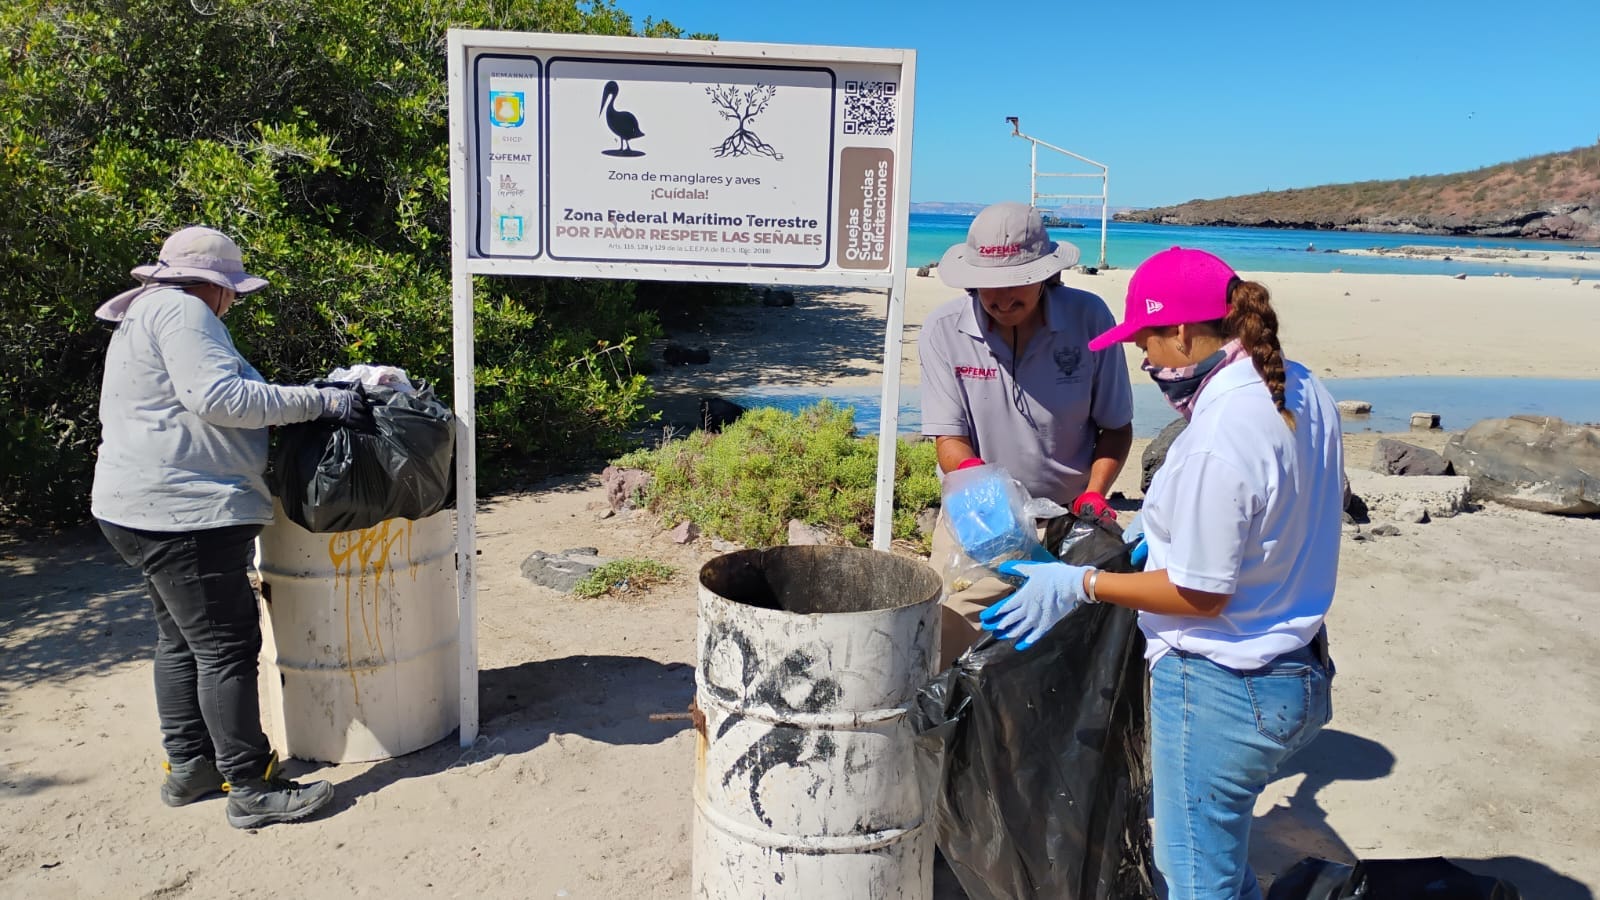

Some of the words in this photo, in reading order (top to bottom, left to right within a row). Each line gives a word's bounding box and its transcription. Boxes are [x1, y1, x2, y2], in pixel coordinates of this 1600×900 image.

[608, 170, 638, 181] Zona
[641, 172, 657, 182] de
[660, 173, 723, 185] manglares
[725, 176, 732, 187] y
[735, 176, 761, 185] aves
[651, 188, 709, 200] ¡Cuídala!
[564, 208, 603, 222] Zona
[608, 210, 668, 224] Federal
[672, 212, 743, 226] Marítimo
[746, 214, 818, 229] Terrestre
[859, 169, 875, 261] Sugerencias
[872, 160, 888, 261] Felicitaciones
[556, 226, 590, 238] POR
[594, 227, 646, 240] FAVOR
[650, 229, 718, 241] RESPETE
[722, 231, 751, 244] LAS
[753, 229, 823, 246] SEÑALES
[845, 208, 861, 260] Quejas
